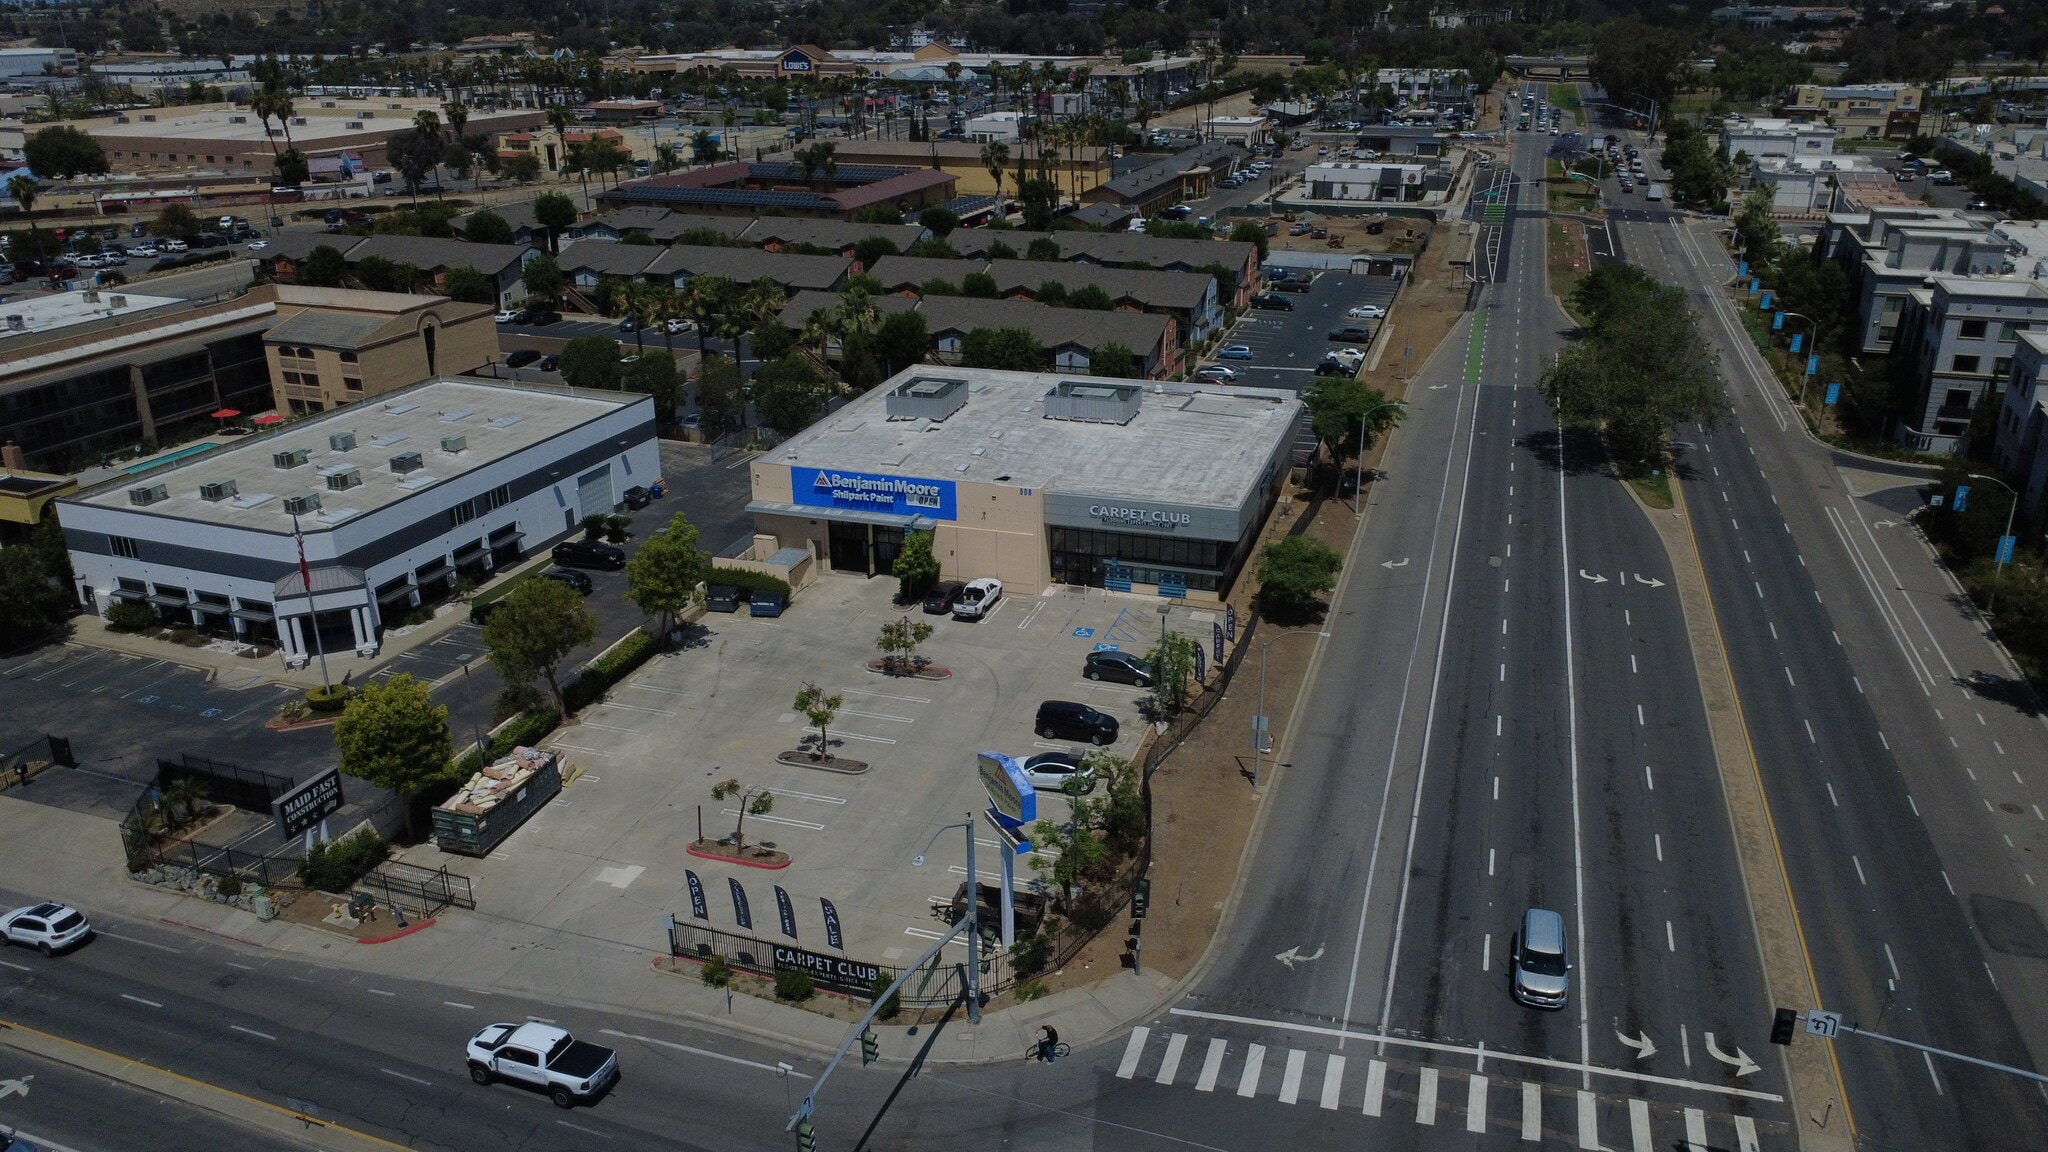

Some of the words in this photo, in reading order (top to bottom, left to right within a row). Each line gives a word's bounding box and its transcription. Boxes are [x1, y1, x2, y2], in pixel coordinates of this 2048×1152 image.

[831, 474, 894, 492] Benjamin
[895, 480, 940, 496] Moore
[832, 489, 870, 502] Shilpark
[871, 493, 895, 504] Paint
[918, 496, 938, 507] OPEN
[1089, 505, 1147, 520] CARPET
[1151, 511, 1191, 524] CLUB
[1226, 609, 1234, 639] OPEN
[284, 792, 312, 815] MAID
[312, 775, 336, 798] FAST
[287, 786, 339, 823] CONSTRUCTION
[689, 877, 704, 915] OPEN
[824, 906, 839, 945] SALE
[775, 948, 832, 972] CARPET
[838, 962, 877, 981] CLUB
